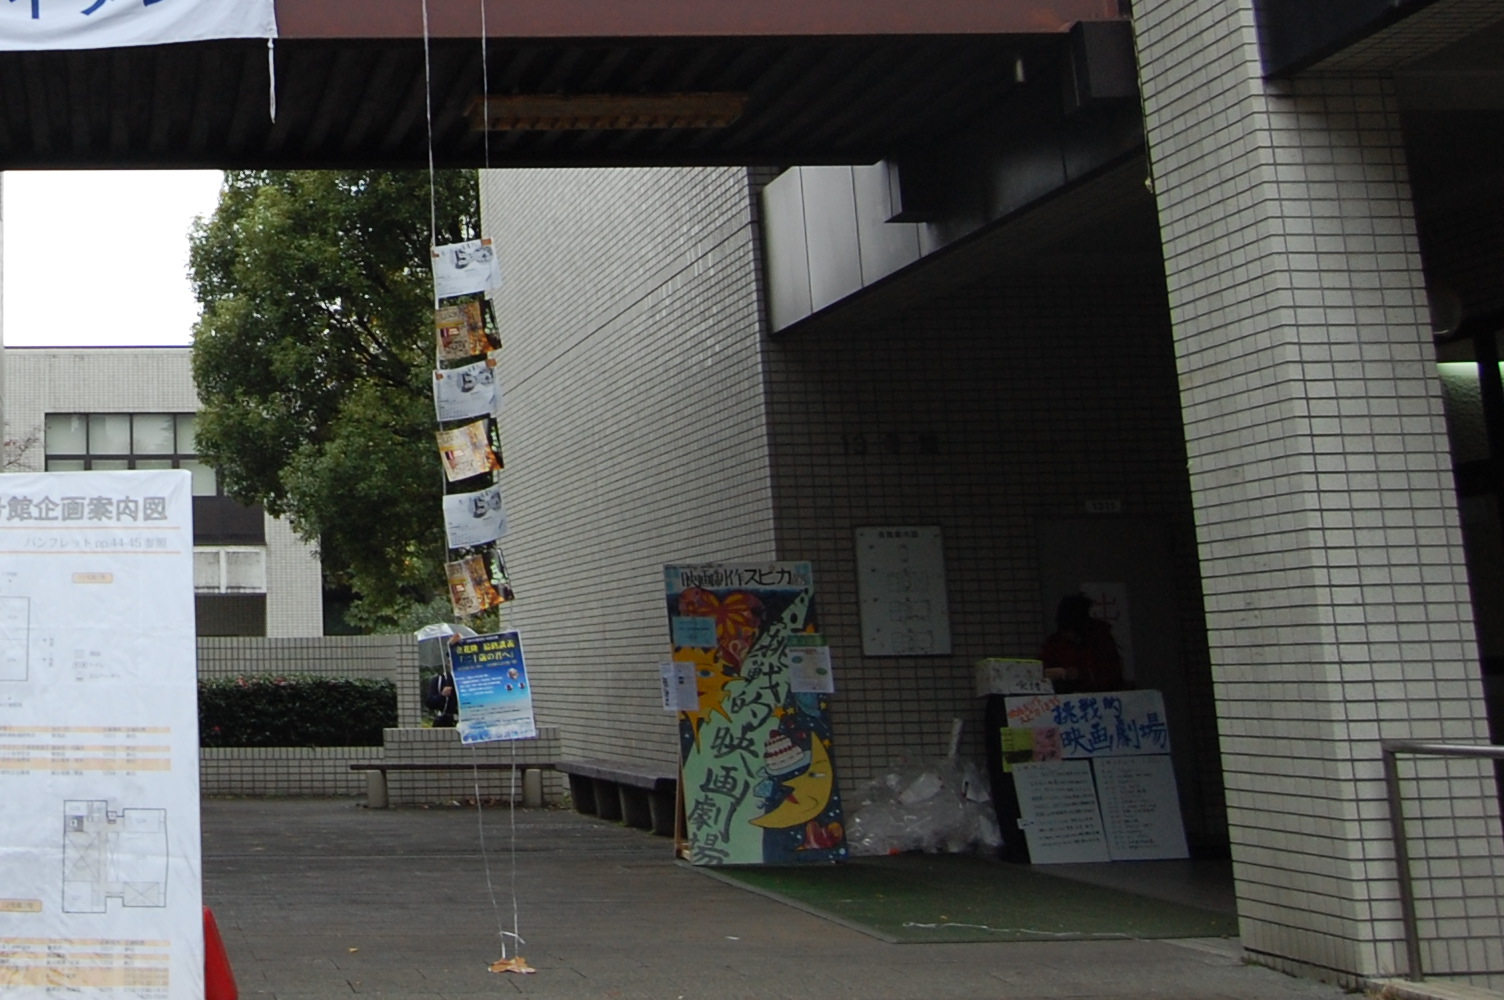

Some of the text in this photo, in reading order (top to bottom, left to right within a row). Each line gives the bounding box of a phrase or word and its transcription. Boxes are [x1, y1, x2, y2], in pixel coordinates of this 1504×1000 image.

[1051, 696, 1123, 725] 挑戦的
[1060, 712, 1168, 755] 映画劇場
